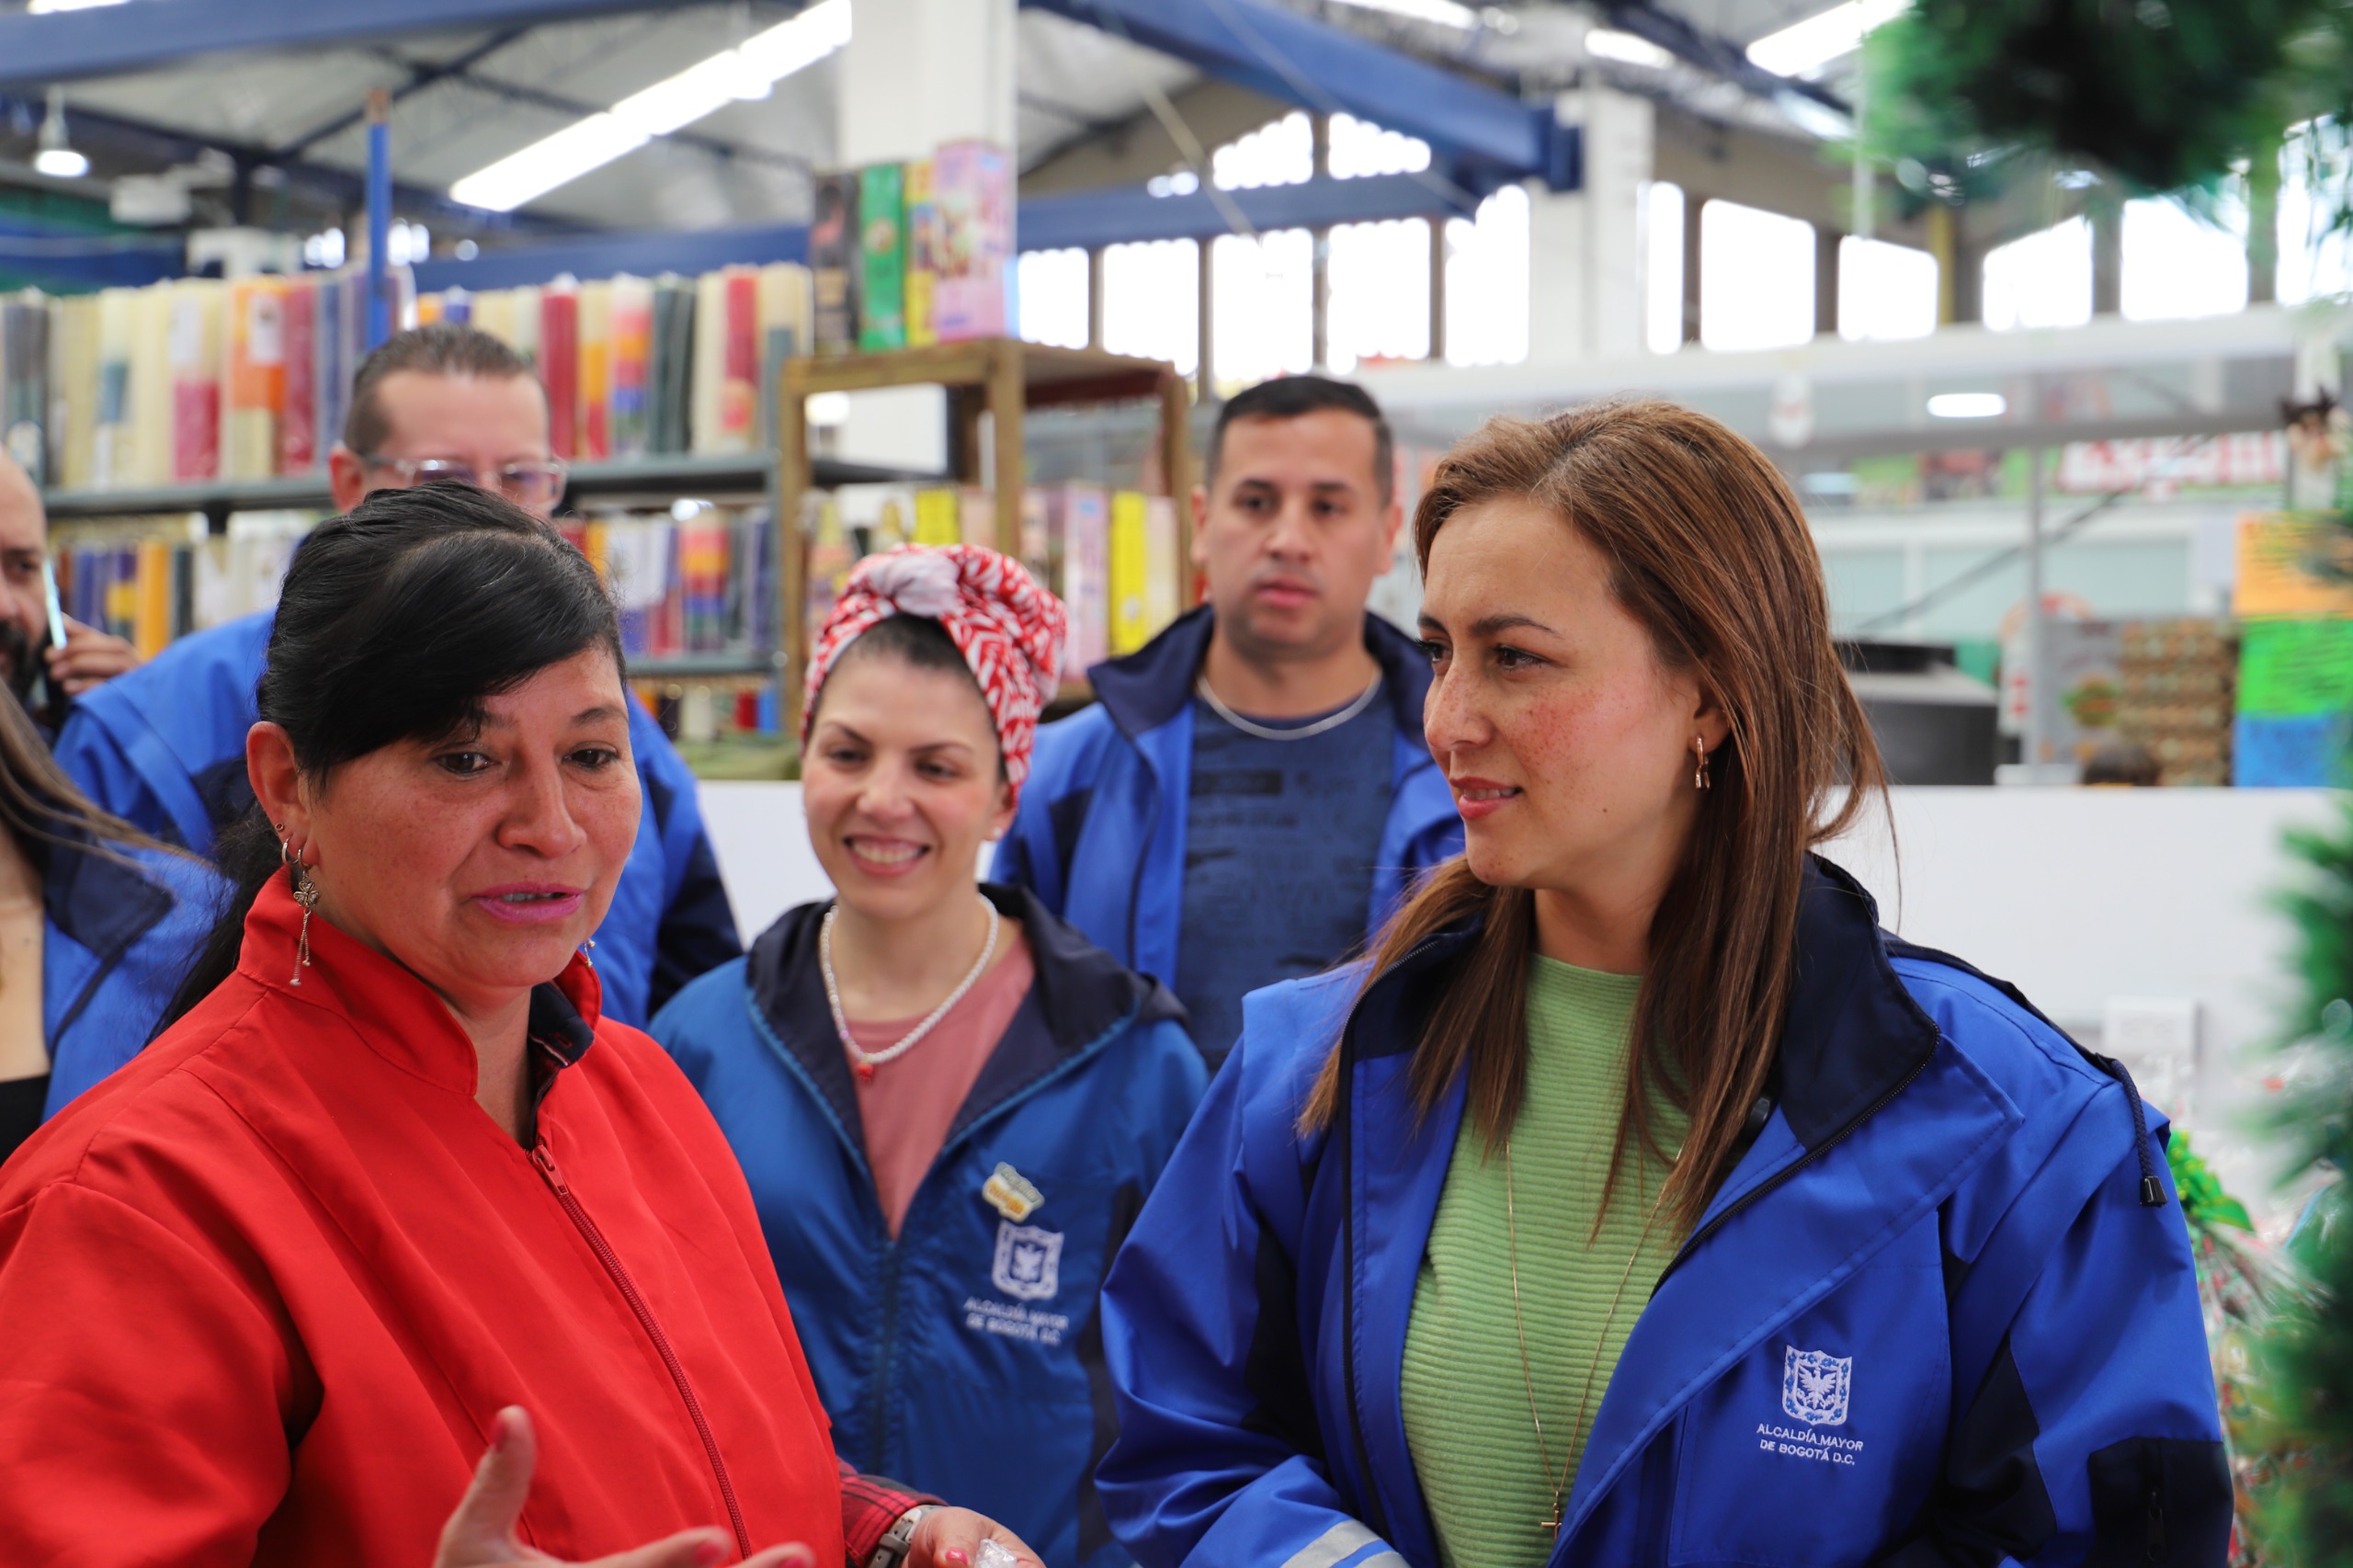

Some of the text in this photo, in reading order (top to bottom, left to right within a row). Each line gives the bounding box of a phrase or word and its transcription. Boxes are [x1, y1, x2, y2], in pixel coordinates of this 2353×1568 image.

[1756, 1423, 1864, 1452] ALCALDÍA MAYOR
[1759, 1438, 1856, 1466] DE BOGOTÁ D.C.
